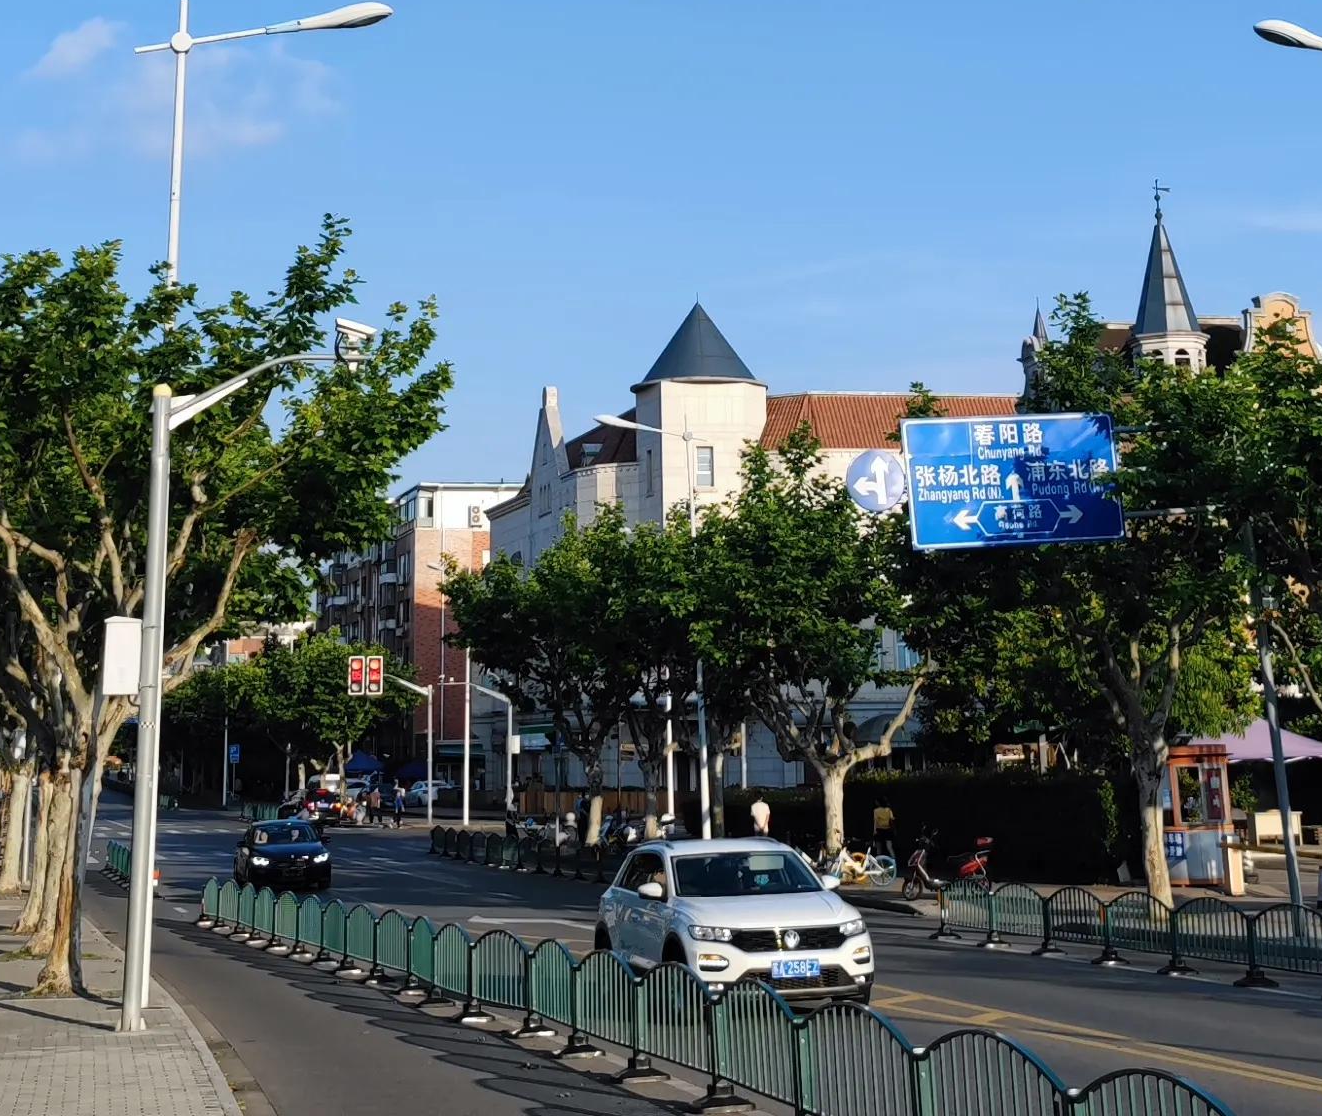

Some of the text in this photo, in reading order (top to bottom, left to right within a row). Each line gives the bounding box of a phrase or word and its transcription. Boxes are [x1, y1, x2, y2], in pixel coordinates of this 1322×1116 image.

[973, 422, 1043, 446] 春阳路
[977, 446, 1025, 462] Chunyang
[915, 463, 1001, 487] 张杨北路
[1025, 458, 1110, 482] 浦东北路
[918, 487, 970, 504] Zhangyang
[1032, 483, 1070, 497] Pudong
